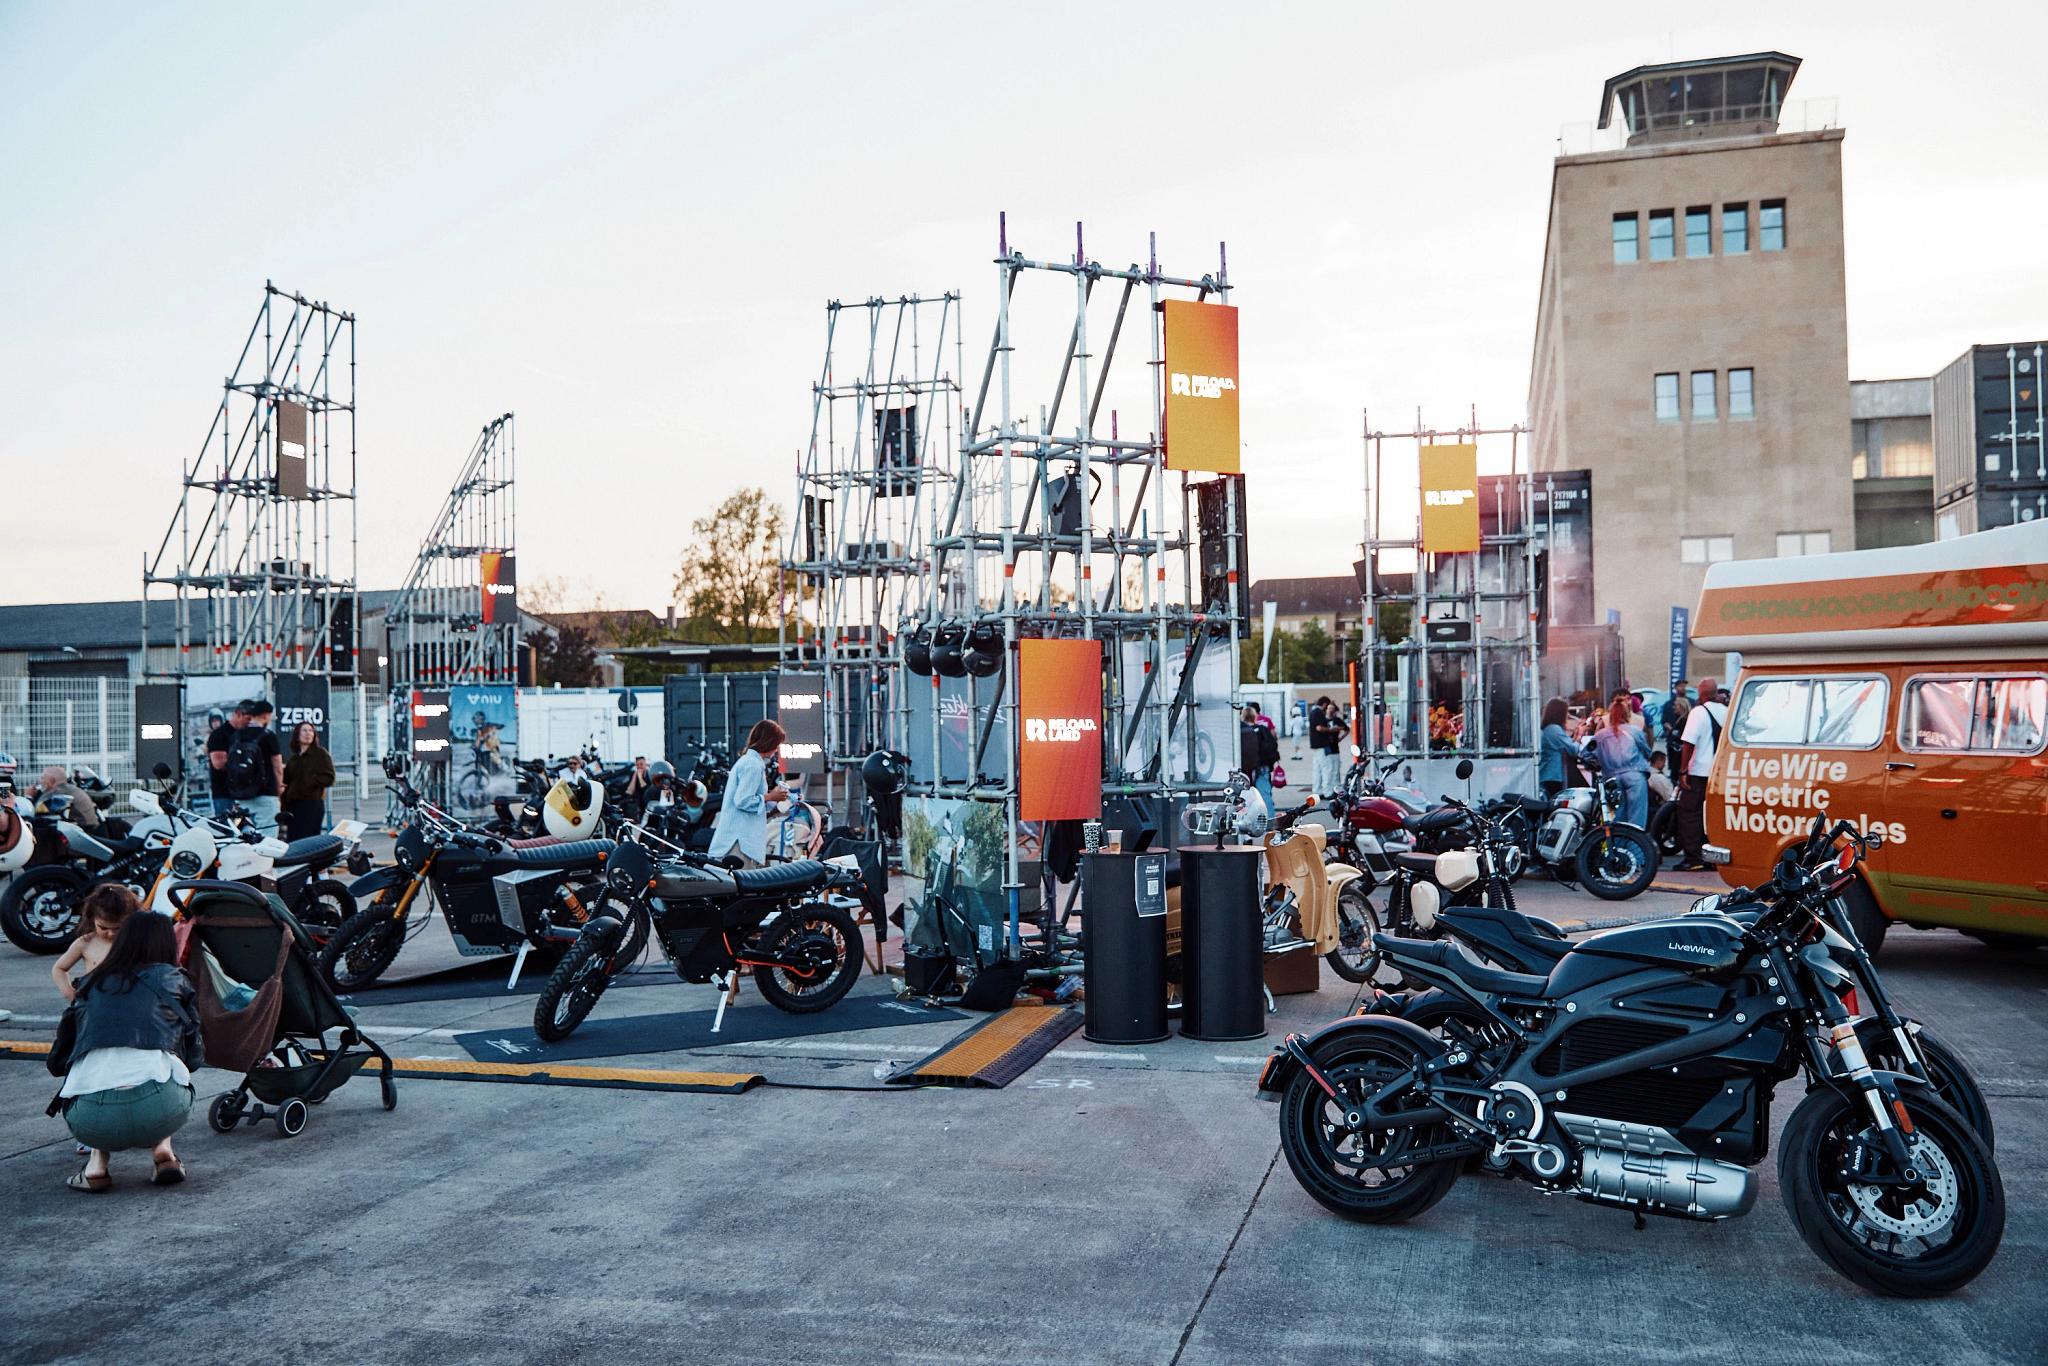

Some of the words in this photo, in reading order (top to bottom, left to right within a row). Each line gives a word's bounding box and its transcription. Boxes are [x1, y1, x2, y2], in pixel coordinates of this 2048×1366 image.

[281, 707, 324, 725] ZERO
[1727, 752, 1848, 782] LiveWire
[1725, 779, 1830, 809] Electric
[1668, 942, 1715, 956] LiveWire
